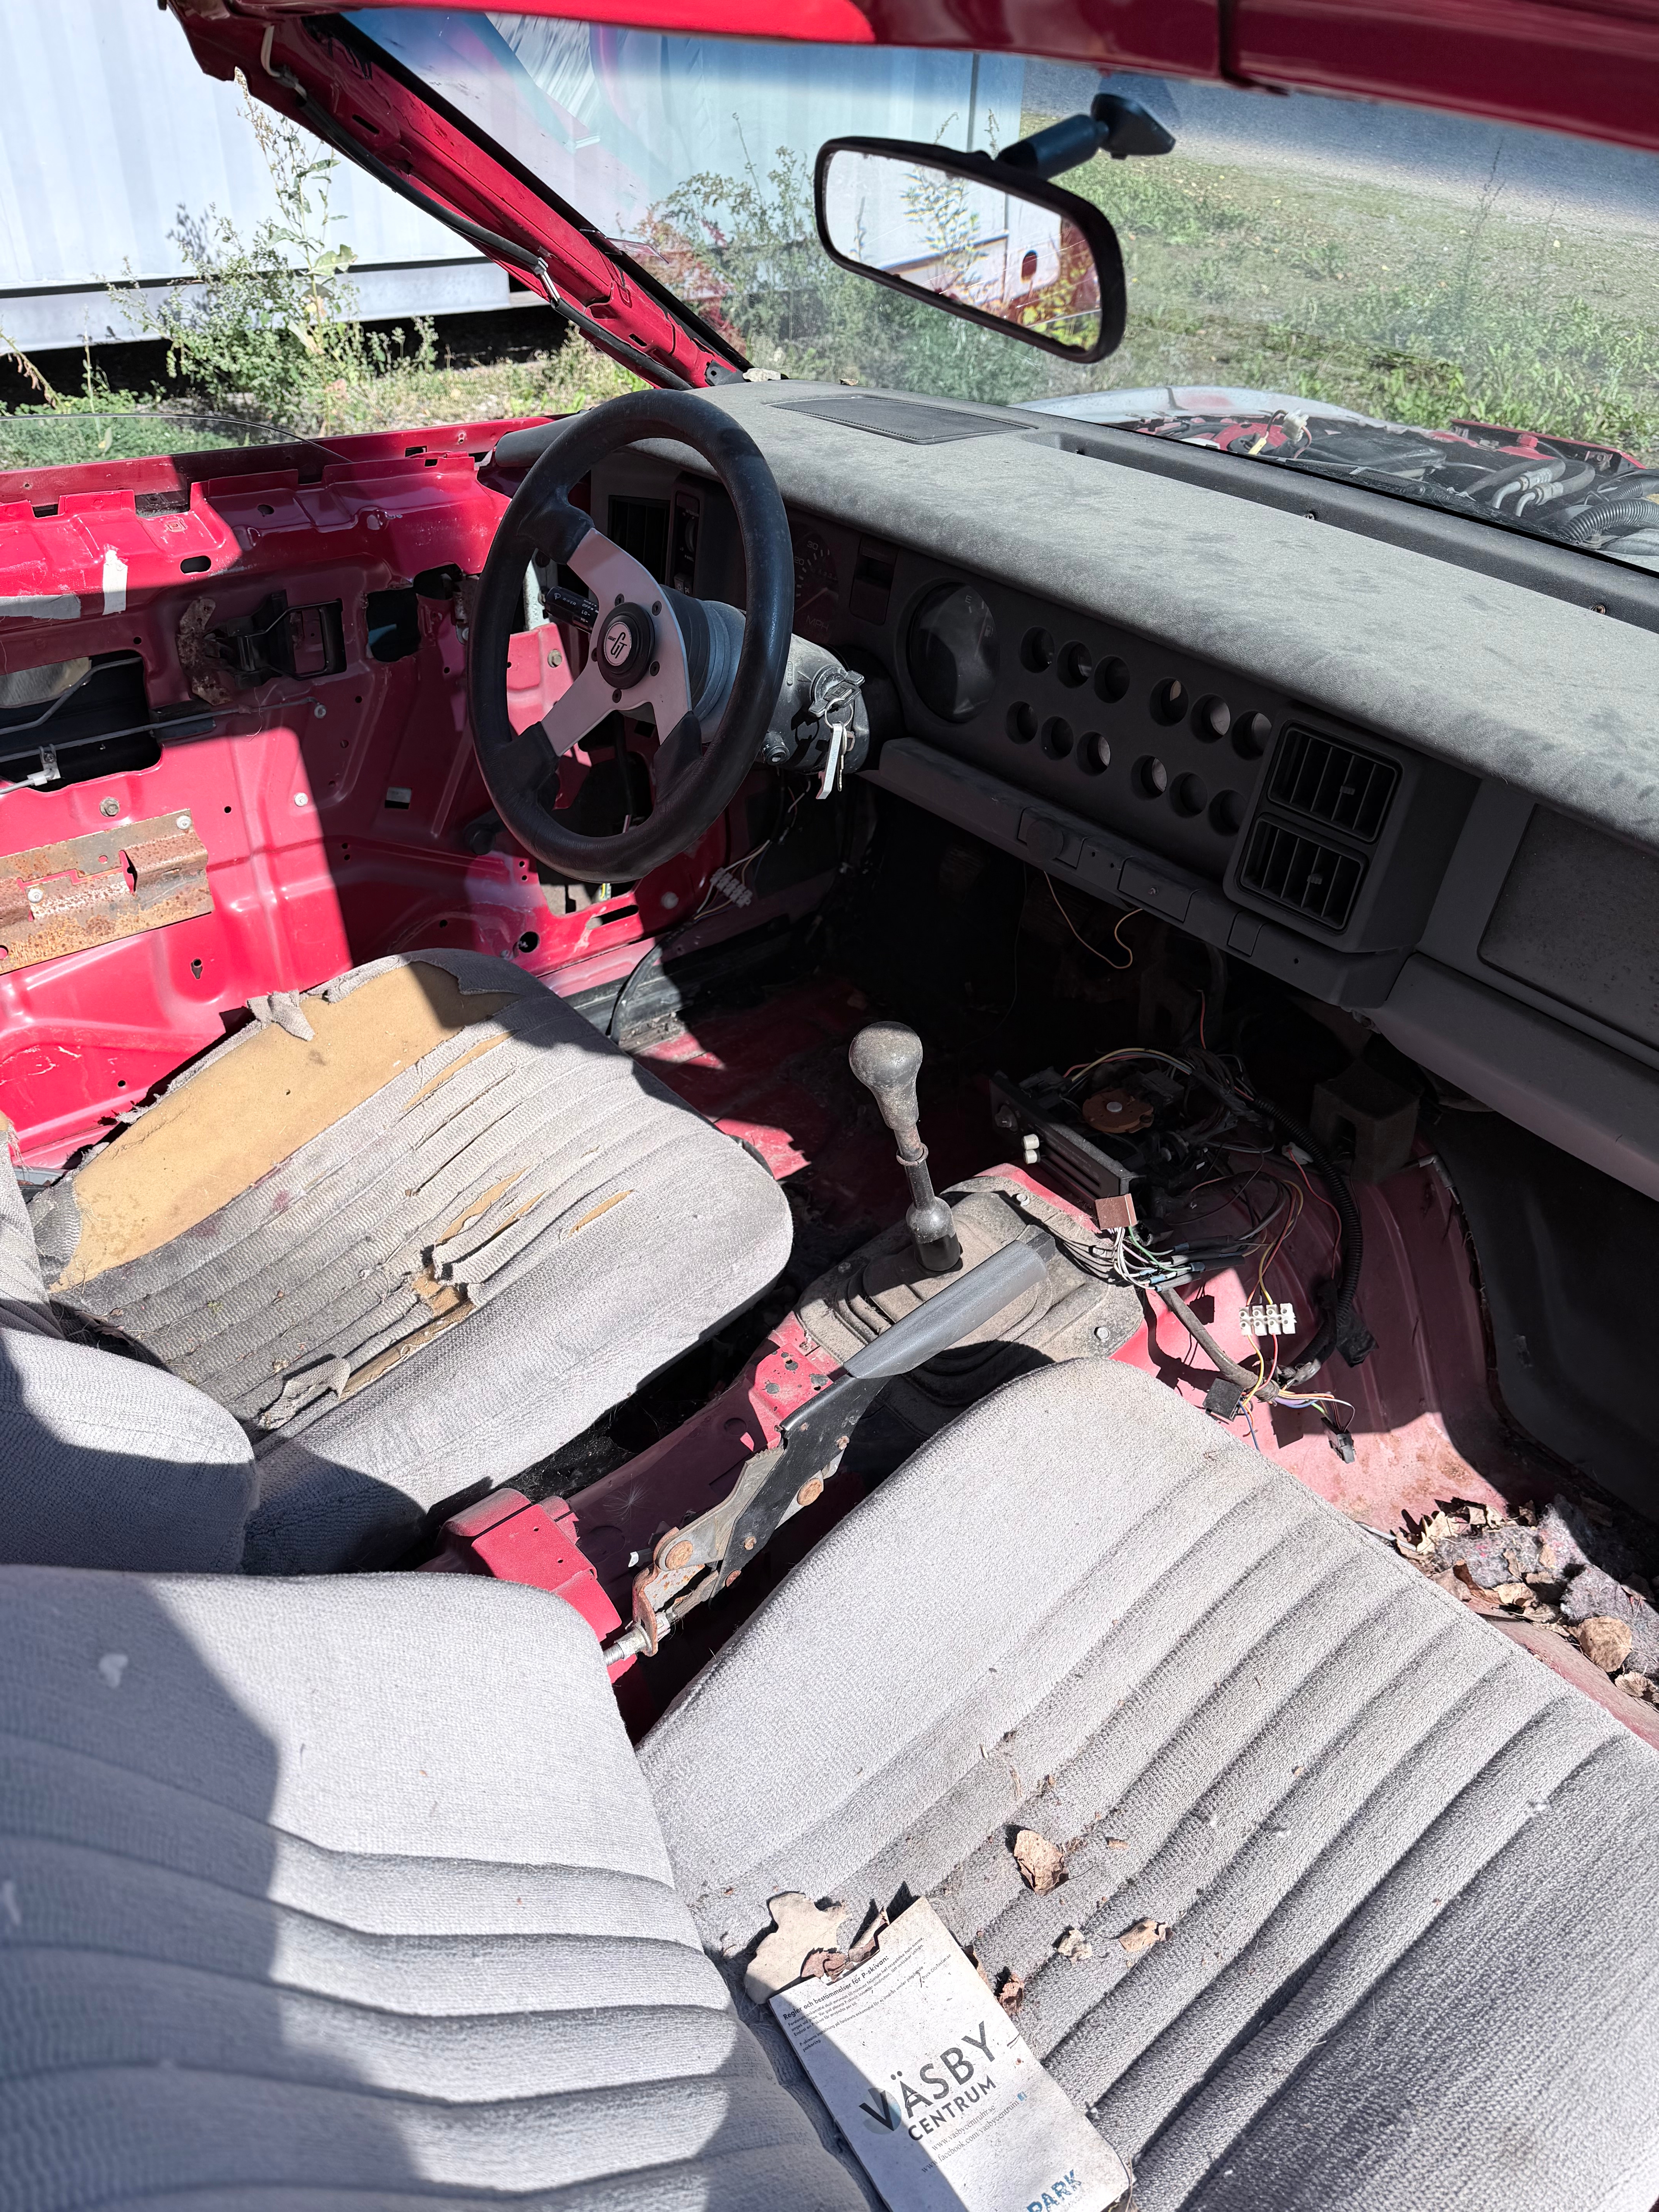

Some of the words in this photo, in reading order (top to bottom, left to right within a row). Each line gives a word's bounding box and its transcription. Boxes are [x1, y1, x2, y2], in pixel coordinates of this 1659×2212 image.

[807, 540, 819, 550] 30
[794, 556, 804, 566] 20
[965, 594, 972, 604] E
[805, 615, 829, 632] MPH
[610, 632, 627, 659] GT
[866, 1972, 881, 1985] följande
[887, 1953, 905, 1969] respektive
[873, 1973, 891, 1987] vindrutan,
[921, 1972, 931, 1980] Tryck
[782, 2007, 802, 2020] Regler
[803, 2001, 814, 2009] och
[812, 1983, 851, 2004] bestämmelser
[851, 1977, 861, 1985] för
[860, 1955, 889, 1978] P-skivan:
[799, 2034, 817, 2047] P-skivans
[839, 2014, 856, 2024] fordonets
[896, 1980, 907, 1990] under
[793, 2027, 806, 2037] Endast
[859, 2021, 996, 2131] VÄSBY
[908, 2075, 996, 2141] CENTRUM
[921, 2098, 1020, 2173] www.facebook.com/vasbycentrum
[931, 2104, 996, 2151] www.vasbycentrum.se
[1026, 2169, 1083, 2212] PARK
